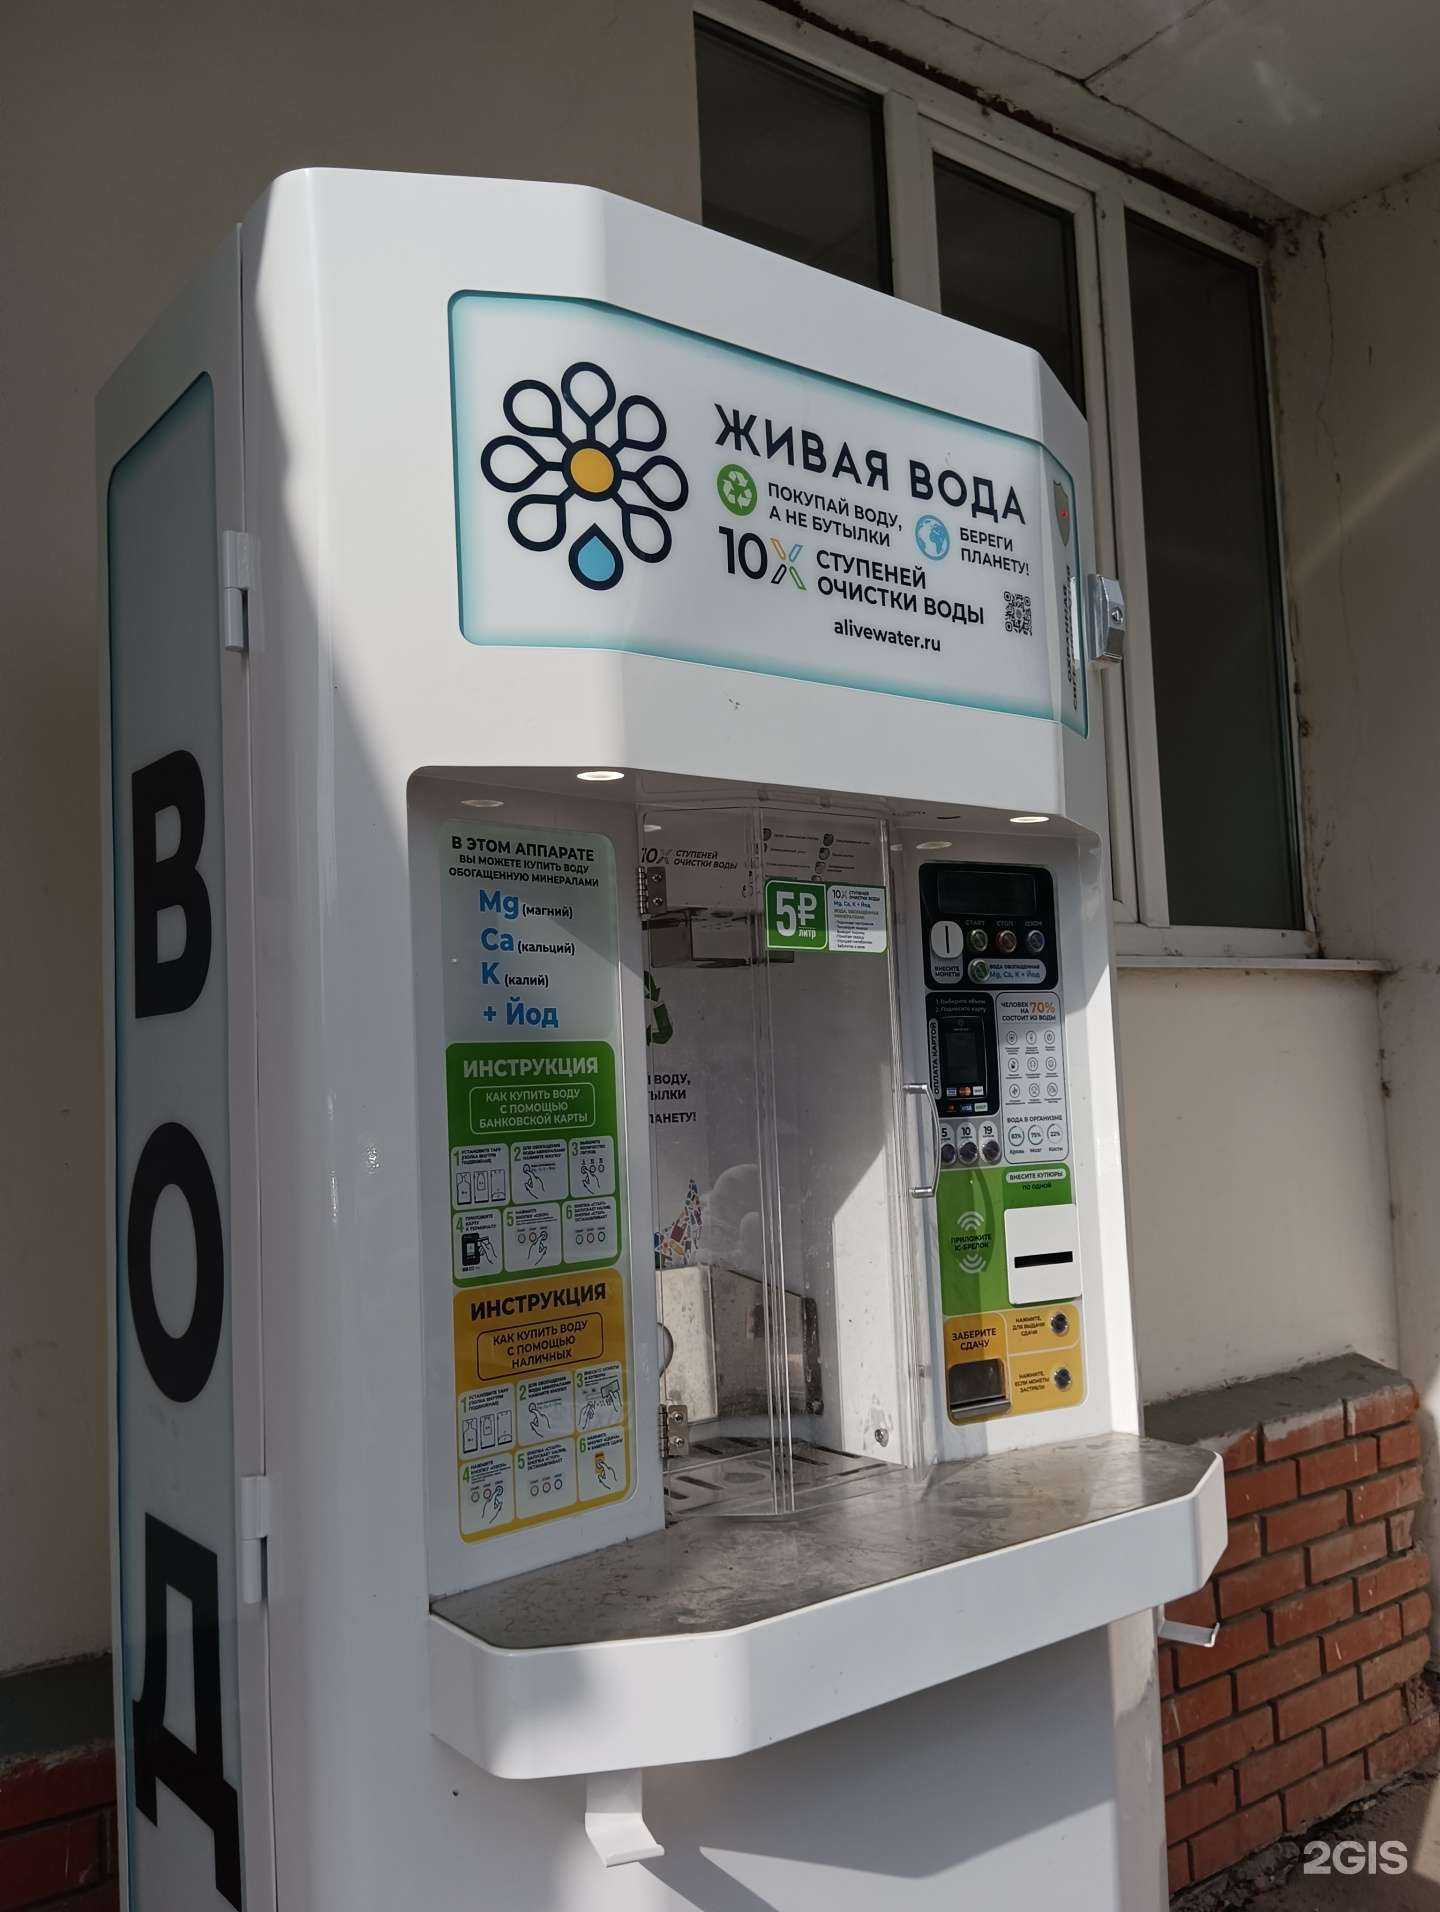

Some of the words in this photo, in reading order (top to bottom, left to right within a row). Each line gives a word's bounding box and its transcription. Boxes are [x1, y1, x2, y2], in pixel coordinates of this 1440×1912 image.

[714, 403, 889, 491] ЖИВАЯ
[909, 459, 1026, 525] ВОДА
[768, 481, 850, 518] ПОКУПАЙ
[854, 505, 902, 532] ВОДУ,
[769, 506, 780, 521] А
[784, 508, 807, 528] НЕ
[812, 515, 890, 547] БУТЫЛКИ
[960, 527, 1013, 552] БЕРЕГИ
[816, 549, 926, 589] СТУПЕНЕЙ
[961, 548, 1030, 576] ПЛАНЕТУ!
[817, 576, 917, 612] ОЧИСТКИ
[924, 600, 984, 625] ВОДЫ
[834, 619, 941, 652] alivewater.ru
[452, 836, 462, 849] В
[467, 837, 511, 853] ЭТОМ
[515, 841, 594, 861] АППАРАТЕ
[676, 849, 718, 859] СТУПЕНЕЙ
[459, 855, 475, 864] ВЫ
[479, 855, 521, 868] МОЖЕТЕ
[524, 859, 561, 871] КУПИТЬ
[564, 863, 589, 874] ВОДУ
[674, 859, 712, 867] ОЧИСТКИ
[714, 861, 738, 869] ВОДЫ
[449, 867, 529, 882] ОБОГАЩЕННУЮ
[532, 873, 599, 887] МИНЕРАЛАМИ
[479, 889, 519, 920] Mg
[522, 904, 573, 919] (магний)
[799, 929, 816, 939] литр
[518, 942, 575, 955] (кальций)
[504, 974, 549, 988] (калий)
[506, 996, 559, 1028] Йод
[1030, 1001, 1056, 1014] 70%
[463, 1056, 599, 1079] ИНСТРУКЦИЯ
[654, 1073, 690, 1085] ВОДУ,
[486, 1091, 507, 1102] КАК
[510, 1089, 549, 1101] КУПИТЬ
[553, 1088, 581, 1100] ВОДУ
[648, 1089, 686, 1100] ЫЛКИ
[500, 1104, 505, 1114] С
[508, 1101, 568, 1114] ПОМОЩЬЮ
[480, 1113, 551, 1128] БАНКОВСКОЙ
[554, 1112, 588, 1124] КАРТЫ
[1029, 1114, 1063, 1122] ОРГАНИЗМЕ
[941, 1127, 948, 1137] 5
[962, 1126, 971, 1136] 10
[983, 1125, 993, 1135] 19
[514, 1147, 522, 1161] 2
[572, 1142, 578, 1156] 3
[453, 1151, 460, 1166] 1
[1009, 1173, 1036, 1181] ВНЕСИТЕ
[1037, 1171, 1063, 1179] КУПЮРЫ
[507, 1211, 513, 1226] 5
[566, 1205, 572, 1219] 6
[456, 1217, 464, 1233] 4
[951, 1233, 992, 1244] ПРИЛОЖИТЕ
[471, 1282, 606, 1321] ИНСТРУКЦИЯ
[492, 1332, 514, 1346] КАК
[516, 1325, 558, 1344] КУПИТЬ
[560, 1320, 589, 1336] ВОДУ
[952, 1328, 997, 1341] ЗАБЕРИТЕ
[507, 1346, 515, 1357] С
[517, 1335, 576, 1356] ПОМОЩЬЮ
[960, 1339, 990, 1351] СДАЧУ
[512, 1349, 572, 1369] НАЛИЧНЫХ
[577, 1373, 583, 1388] 3
[1029, 1377, 1050, 1385] МОНЕТЫ
[519, 1385, 527, 1401] 2
[580, 1438, 586, 1452] 6
[518, 1454, 525, 1469] 5
[463, 1467, 470, 1483] 4
